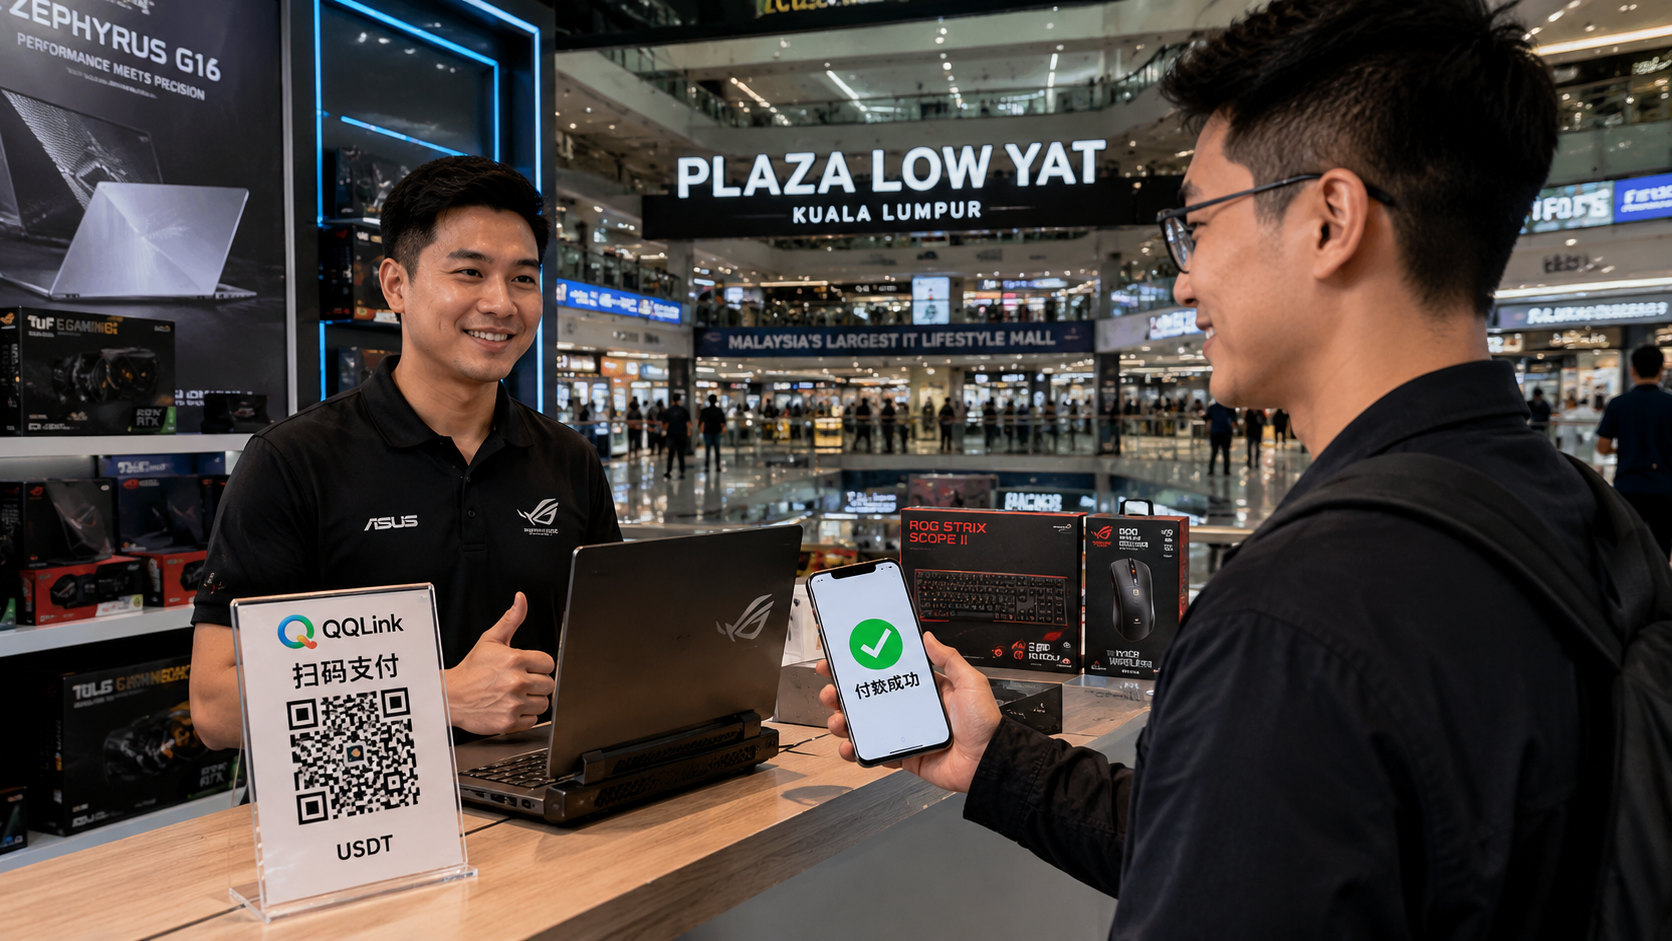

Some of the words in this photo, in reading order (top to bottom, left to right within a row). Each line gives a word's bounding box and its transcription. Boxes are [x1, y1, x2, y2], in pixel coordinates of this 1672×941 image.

[9, 0, 168, 66] ZEPHYRUS
[175, 47, 221, 82] G16
[17, 32, 111, 73] PERFORMANCE
[113, 62, 152, 85] MEETS
[154, 75, 205, 101] PRECISION
[677, 151, 856, 199] PLAZA
[871, 144, 993, 193] LOW
[1004, 139, 1107, 187] YAT
[792, 205, 872, 224] KUALA
[882, 200, 982, 222] LUMPUR
[728, 333, 823, 350] MALAYSIA'S
[826, 332, 899, 349] LARGEST
[902, 332, 919, 348] IT
[921, 330, 1006, 348] LIFESTYLE
[1009, 330, 1056, 347] MALL
[364, 515, 419, 531] ASUS
[909, 520, 940, 533] ROG
[943, 521, 987, 534] STRIX
[909, 532, 957, 545] SCOPE
[322, 613, 404, 639] QQLink
[292, 652, 399, 690] 扫码支付
[336, 834, 393, 861] USDT
